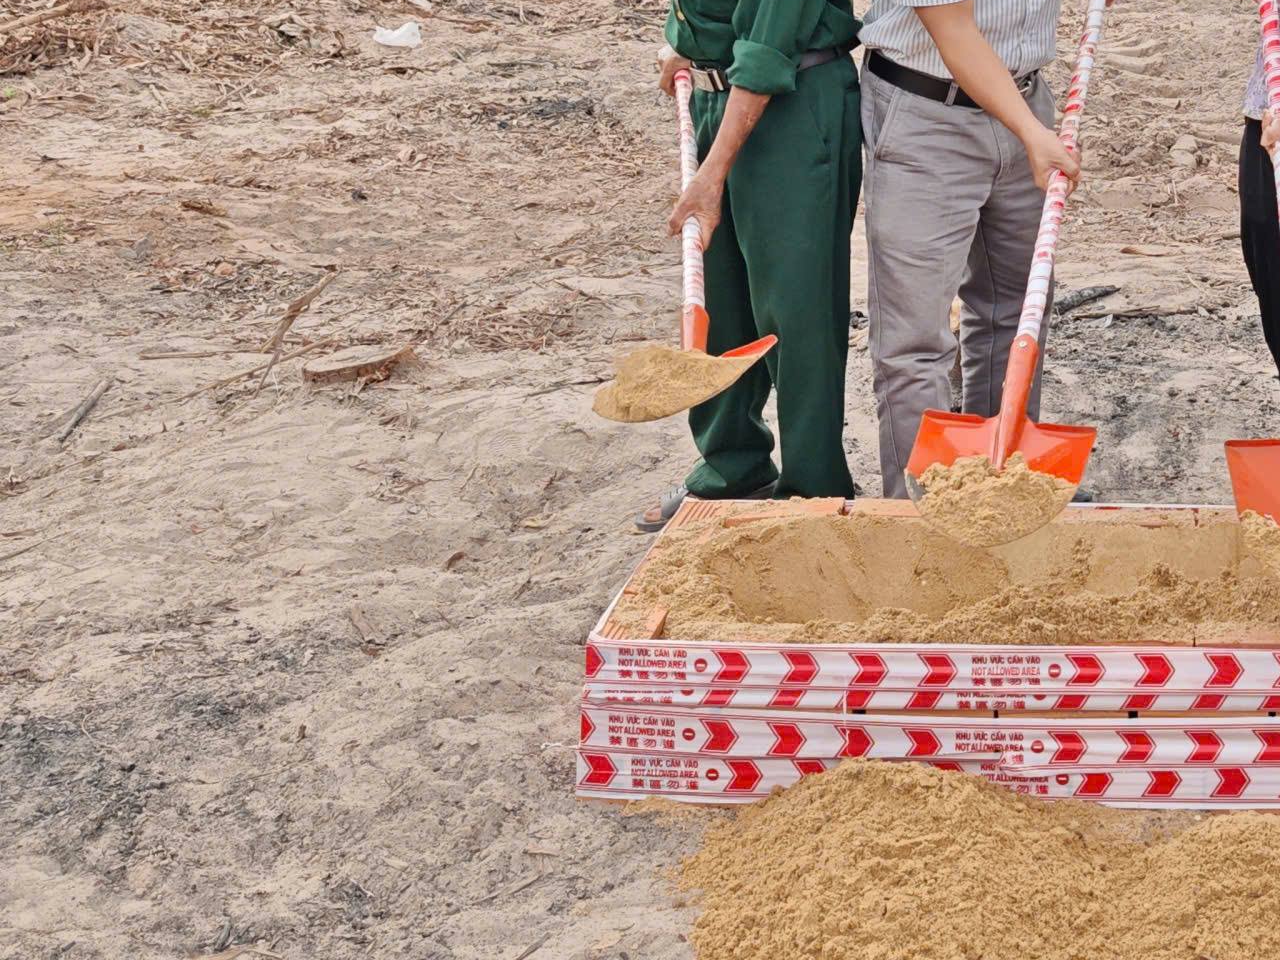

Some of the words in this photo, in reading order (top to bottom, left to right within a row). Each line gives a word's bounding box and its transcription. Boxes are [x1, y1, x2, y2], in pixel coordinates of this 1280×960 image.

[618, 648, 634, 656] KHU
[972, 656, 987, 664] KHU
[634, 660, 667, 668] ALLOWED
[668, 661, 686, 669] AREA
[972, 667, 987, 675] NOT
[988, 667, 1020, 675] ALLOWED
[1022, 667, 1040, 675] AREA
[609, 715, 623, 723] KHU
[624, 727, 655, 736] ALLOWED
[657, 728, 675, 737] AREA
[956, 732, 970, 740] KHU
[647, 769, 678, 778] ALLOWED
[680, 770, 698, 778] AREA
